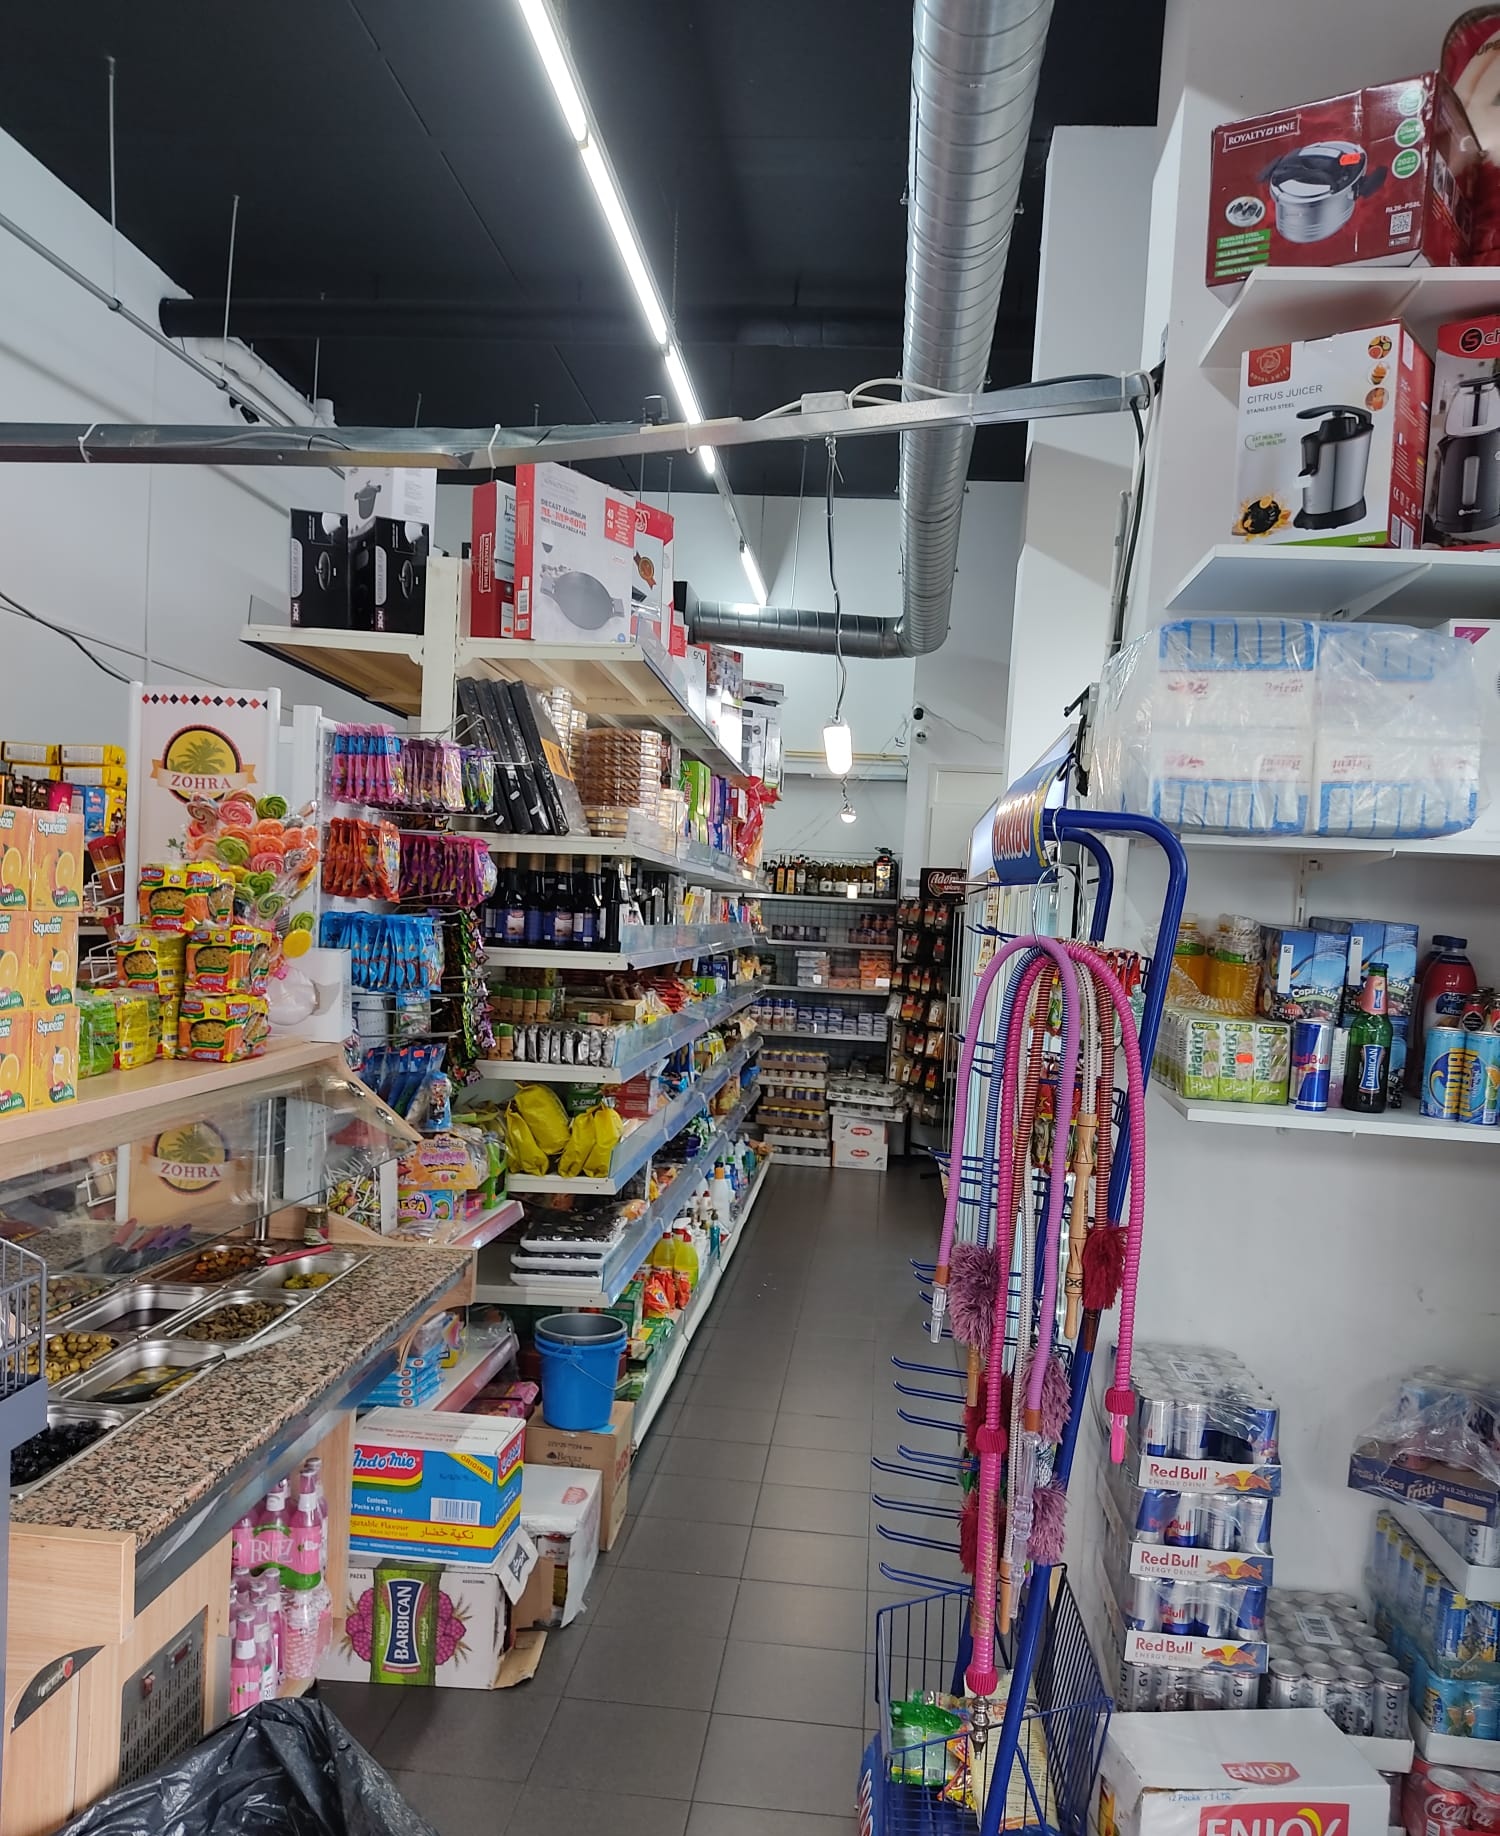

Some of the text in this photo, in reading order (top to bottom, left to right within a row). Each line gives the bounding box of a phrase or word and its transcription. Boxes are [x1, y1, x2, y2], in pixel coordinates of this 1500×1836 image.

[1227, 121, 1296, 145] ROYALTY LINE
[1246, 384, 1323, 404] CITRUS JUICER
[1246, 405, 1277, 415] STAINLESS
[170, 773, 232, 790] ZOHRA
[1291, 987, 1338, 1001] Capri-Sun
[160, 1161, 222, 1178] ZOHRA
[400, 1199, 427, 1214] EGA
[460, 1454, 492, 1480] ORIGINAL
[1150, 1463, 1208, 1481] Red Bull
[1406, 1480, 1437, 1499] Fristi
[1140, 1551, 1199, 1569] Red Bull
[1140, 1565, 1171, 1574] ENERGY
[393, 1585, 412, 1661] BARBICAN
[1136, 1637, 1193, 1655] Red Bull
[1227, 1764, 1292, 1780] ENJOY
[1206, 1817, 1342, 1836] ENJOY
